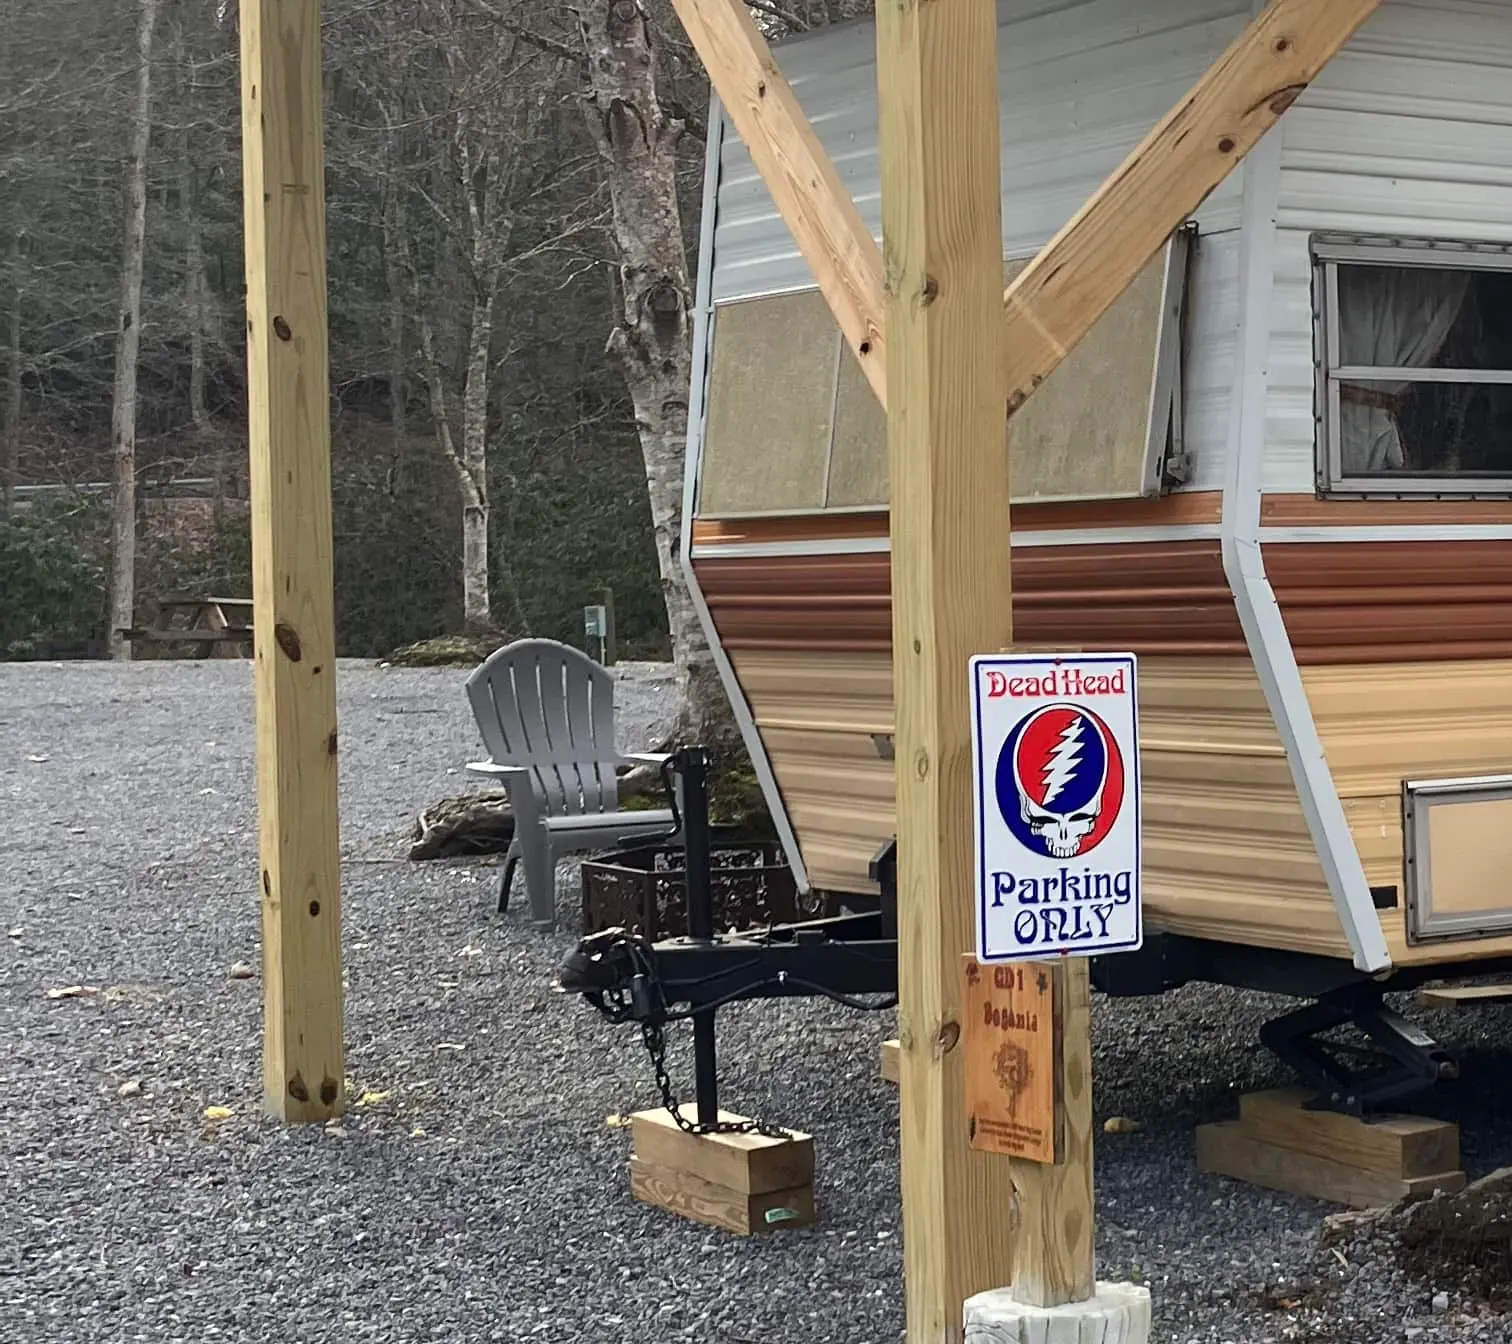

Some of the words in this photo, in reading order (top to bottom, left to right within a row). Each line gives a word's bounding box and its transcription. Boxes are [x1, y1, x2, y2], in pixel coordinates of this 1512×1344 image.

[986, 670, 1058, 697] Dead
[1061, 668, 1126, 696] Head
[991, 867, 1132, 907] Parking
[1014, 903, 1114, 945] ONLY
